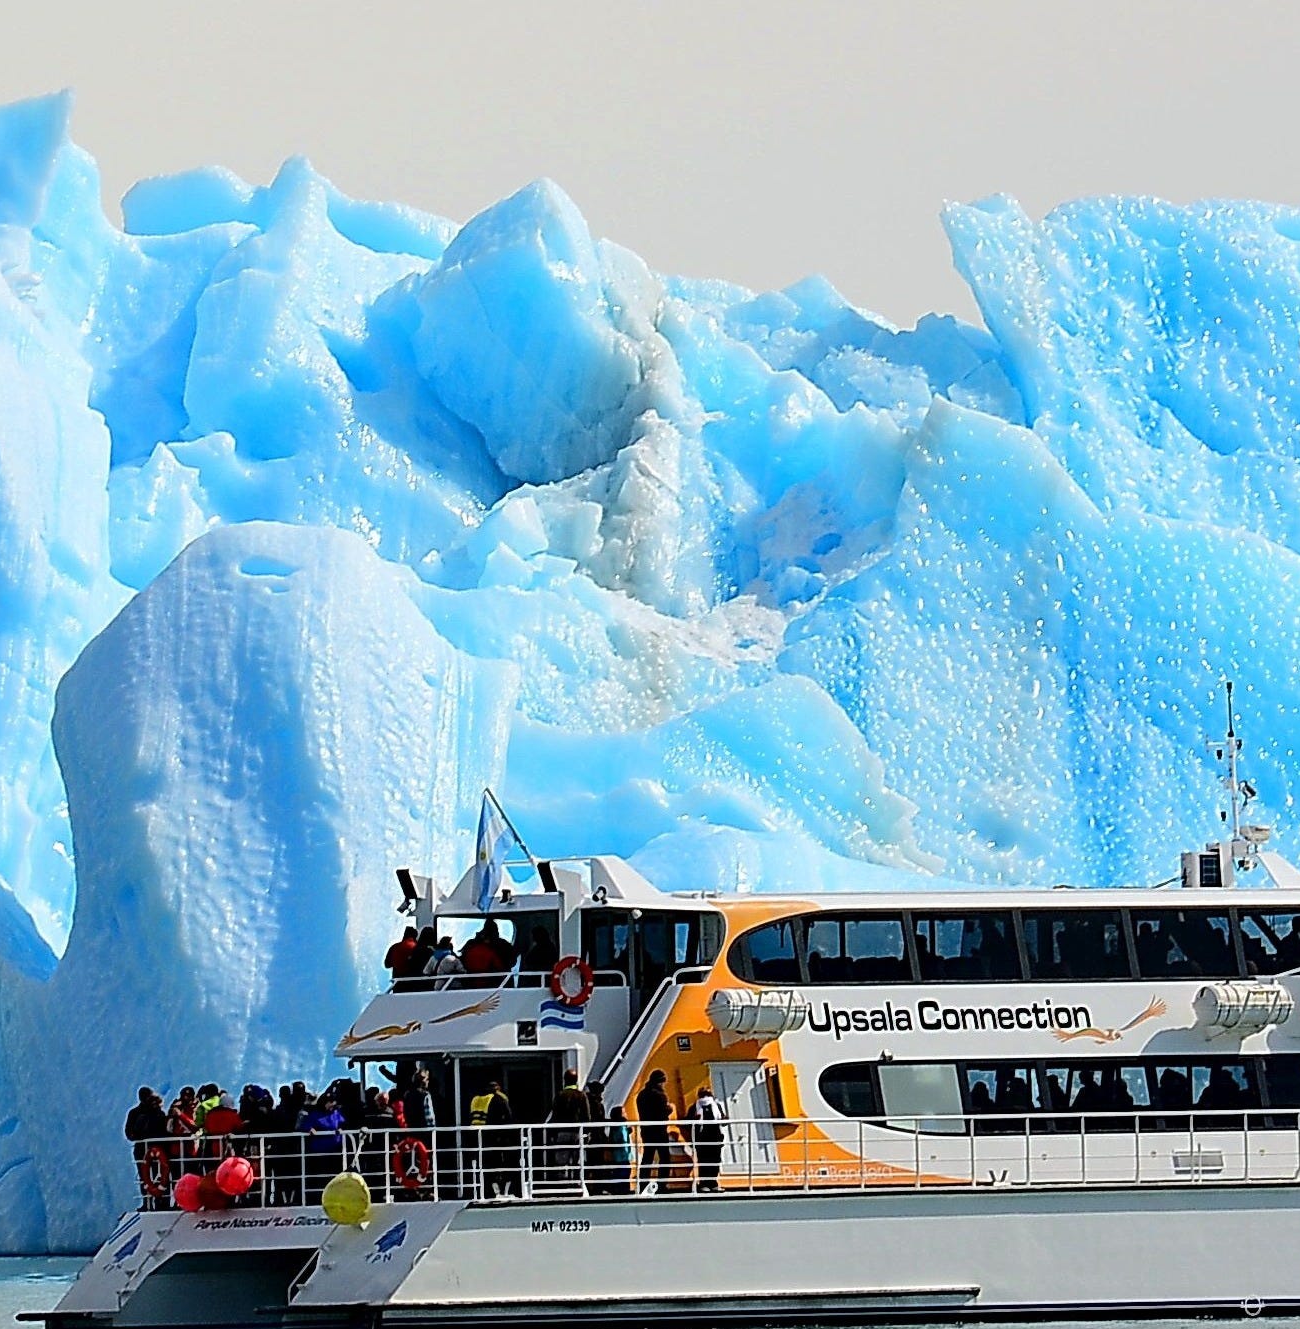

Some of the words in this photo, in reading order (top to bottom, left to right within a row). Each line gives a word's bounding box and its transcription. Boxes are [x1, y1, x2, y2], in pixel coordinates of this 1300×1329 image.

[807, 1001, 913, 1041] Upsala
[917, 999, 1092, 1031] Connection
[194, 1219, 231, 1230] Parque
[230, 1217, 273, 1228] Nacional
[531, 1220, 555, 1233] MAT
[559, 1220, 590, 1232] 02339
